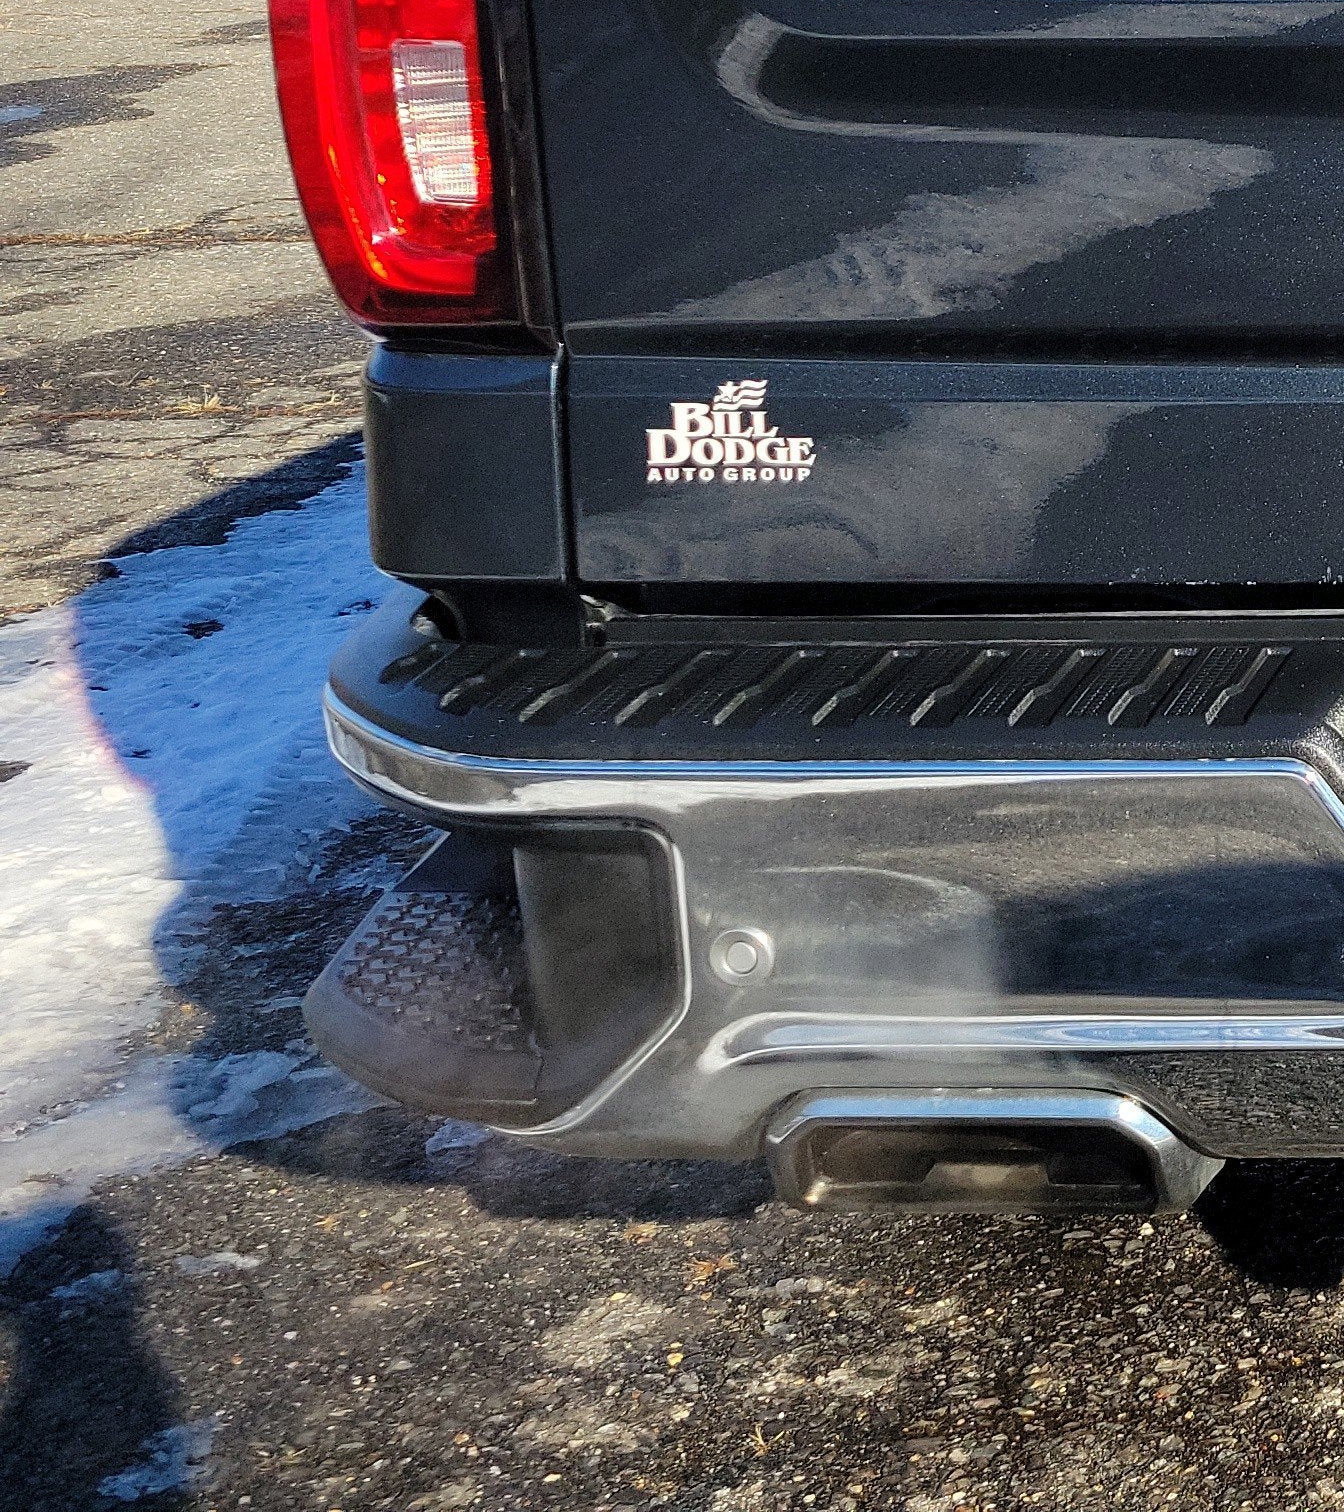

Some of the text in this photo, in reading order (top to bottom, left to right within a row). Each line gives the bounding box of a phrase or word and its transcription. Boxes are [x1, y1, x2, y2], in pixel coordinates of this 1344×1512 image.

[669, 402, 779, 439] BILL
[645, 428, 817, 467] DODGE
[647, 467, 812, 483] AUTO GROUP
